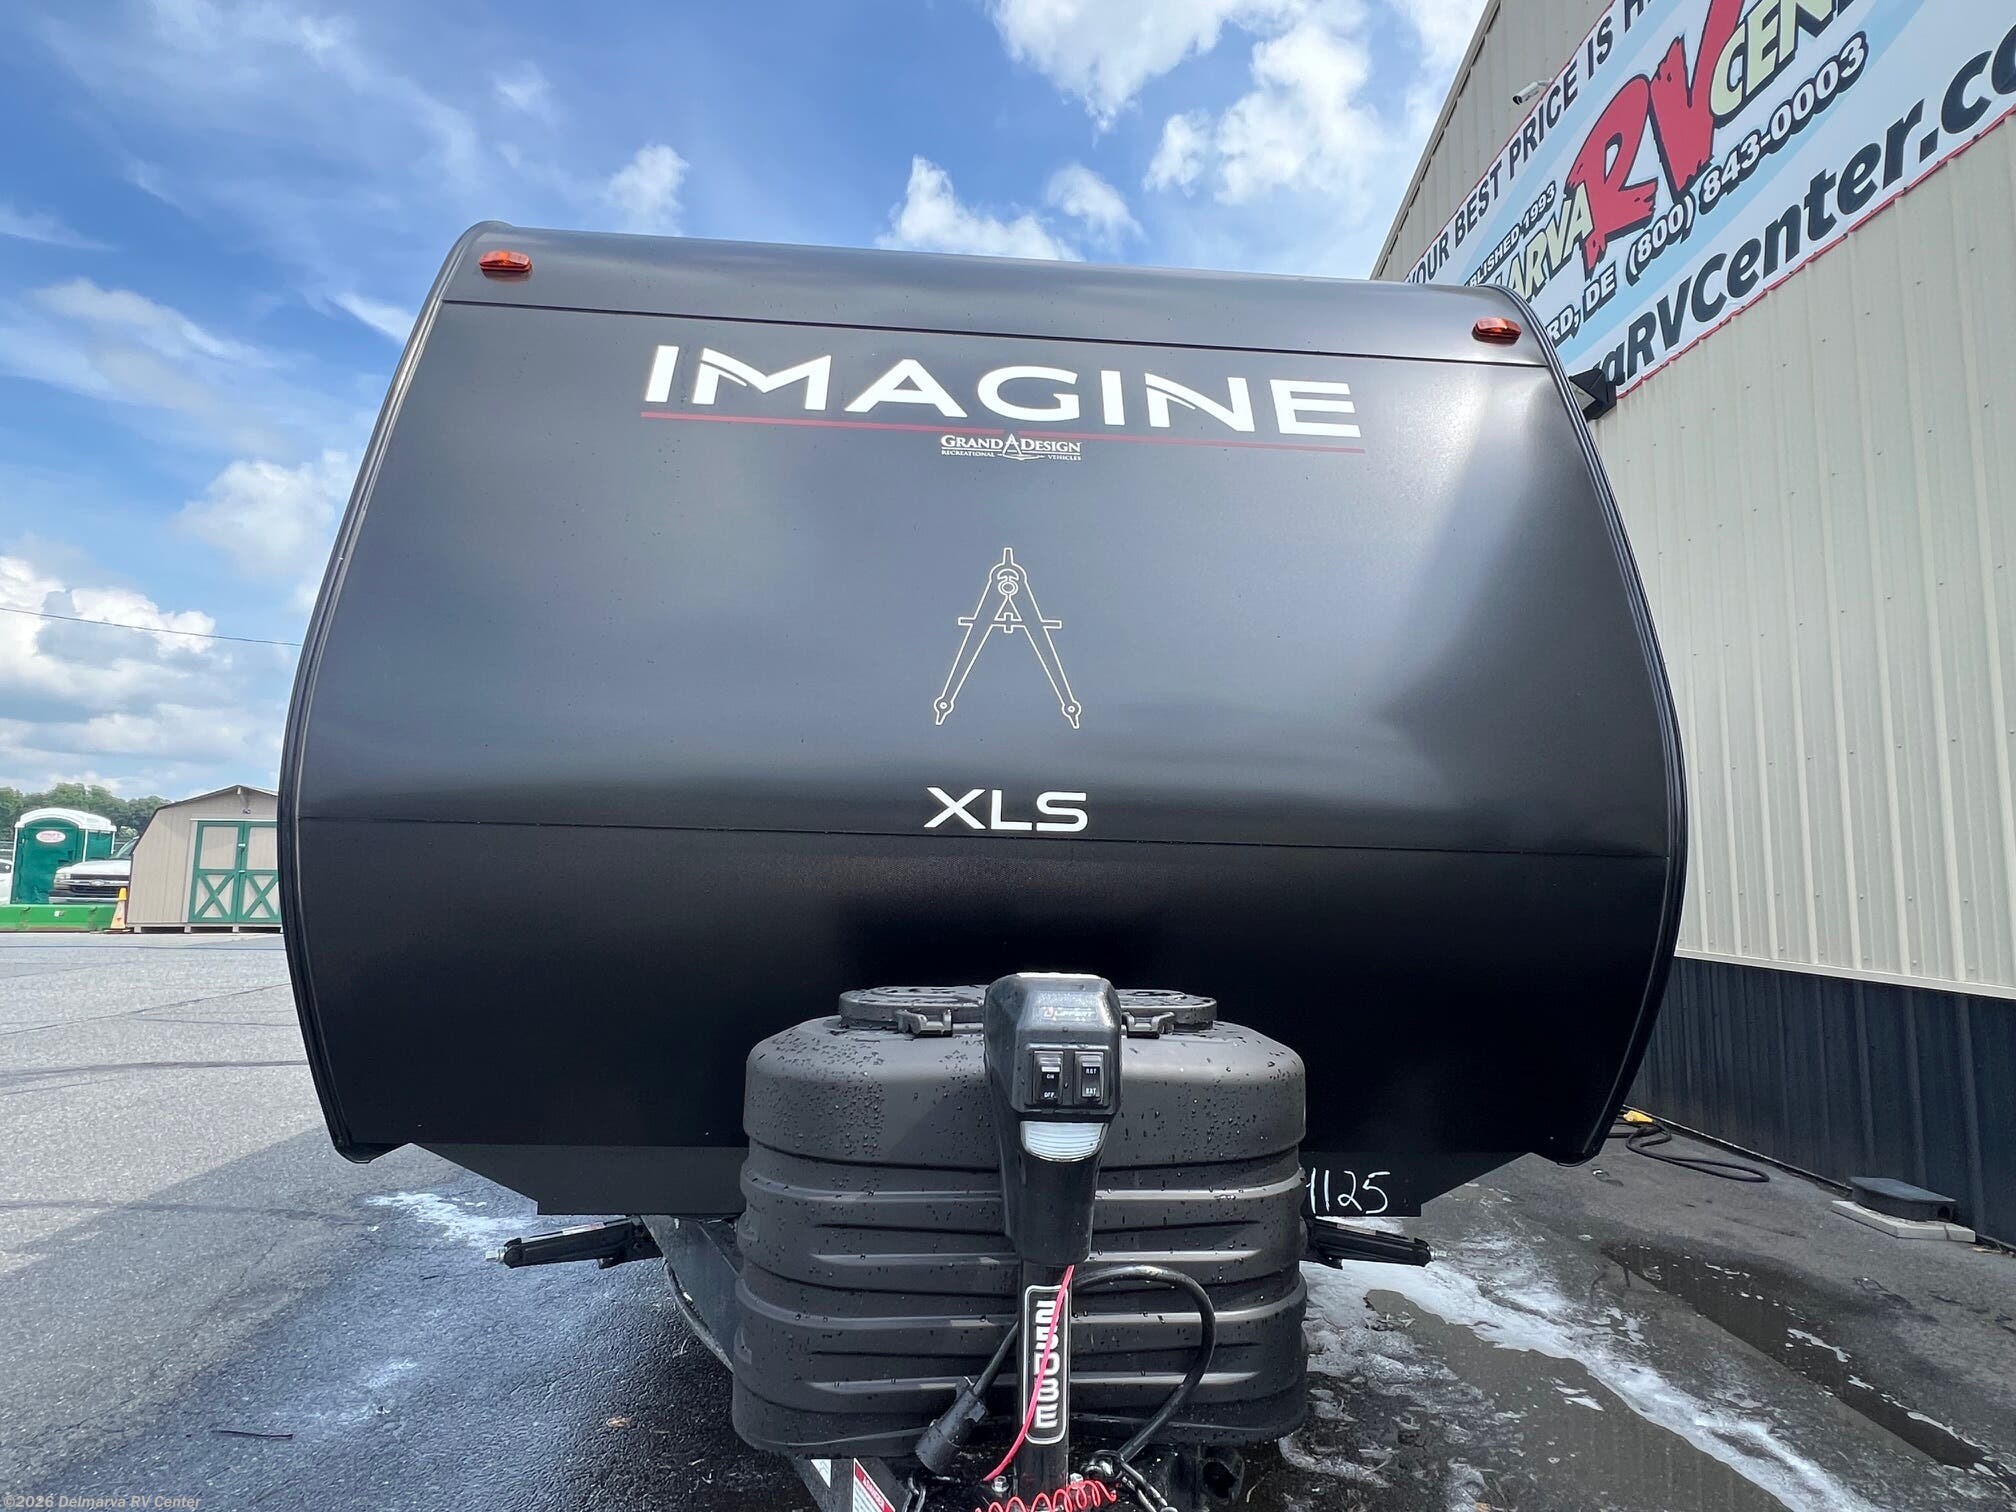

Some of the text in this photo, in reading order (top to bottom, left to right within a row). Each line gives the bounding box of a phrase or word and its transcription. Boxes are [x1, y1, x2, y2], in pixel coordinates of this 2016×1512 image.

[1455, 162, 1502, 249] BEST
[1509, 59, 1578, 181] PRICE
[1587, 16, 1614, 81] IS
[1583, 263, 1617, 315] DE
[1628, 194, 1693, 277] (800)
[1701, 36, 1866, 205] 843-0003
[1464, 182, 1557, 287] BLISHED 1993
[1495, 181, 1595, 302] ARVA
[645, 345, 1362, 438] IMAGINE
[940, 434, 1082, 453] GRAND DESIGN
[941, 449, 995, 457] RECREATIONAL
[924, 787, 1089, 832] XLS
